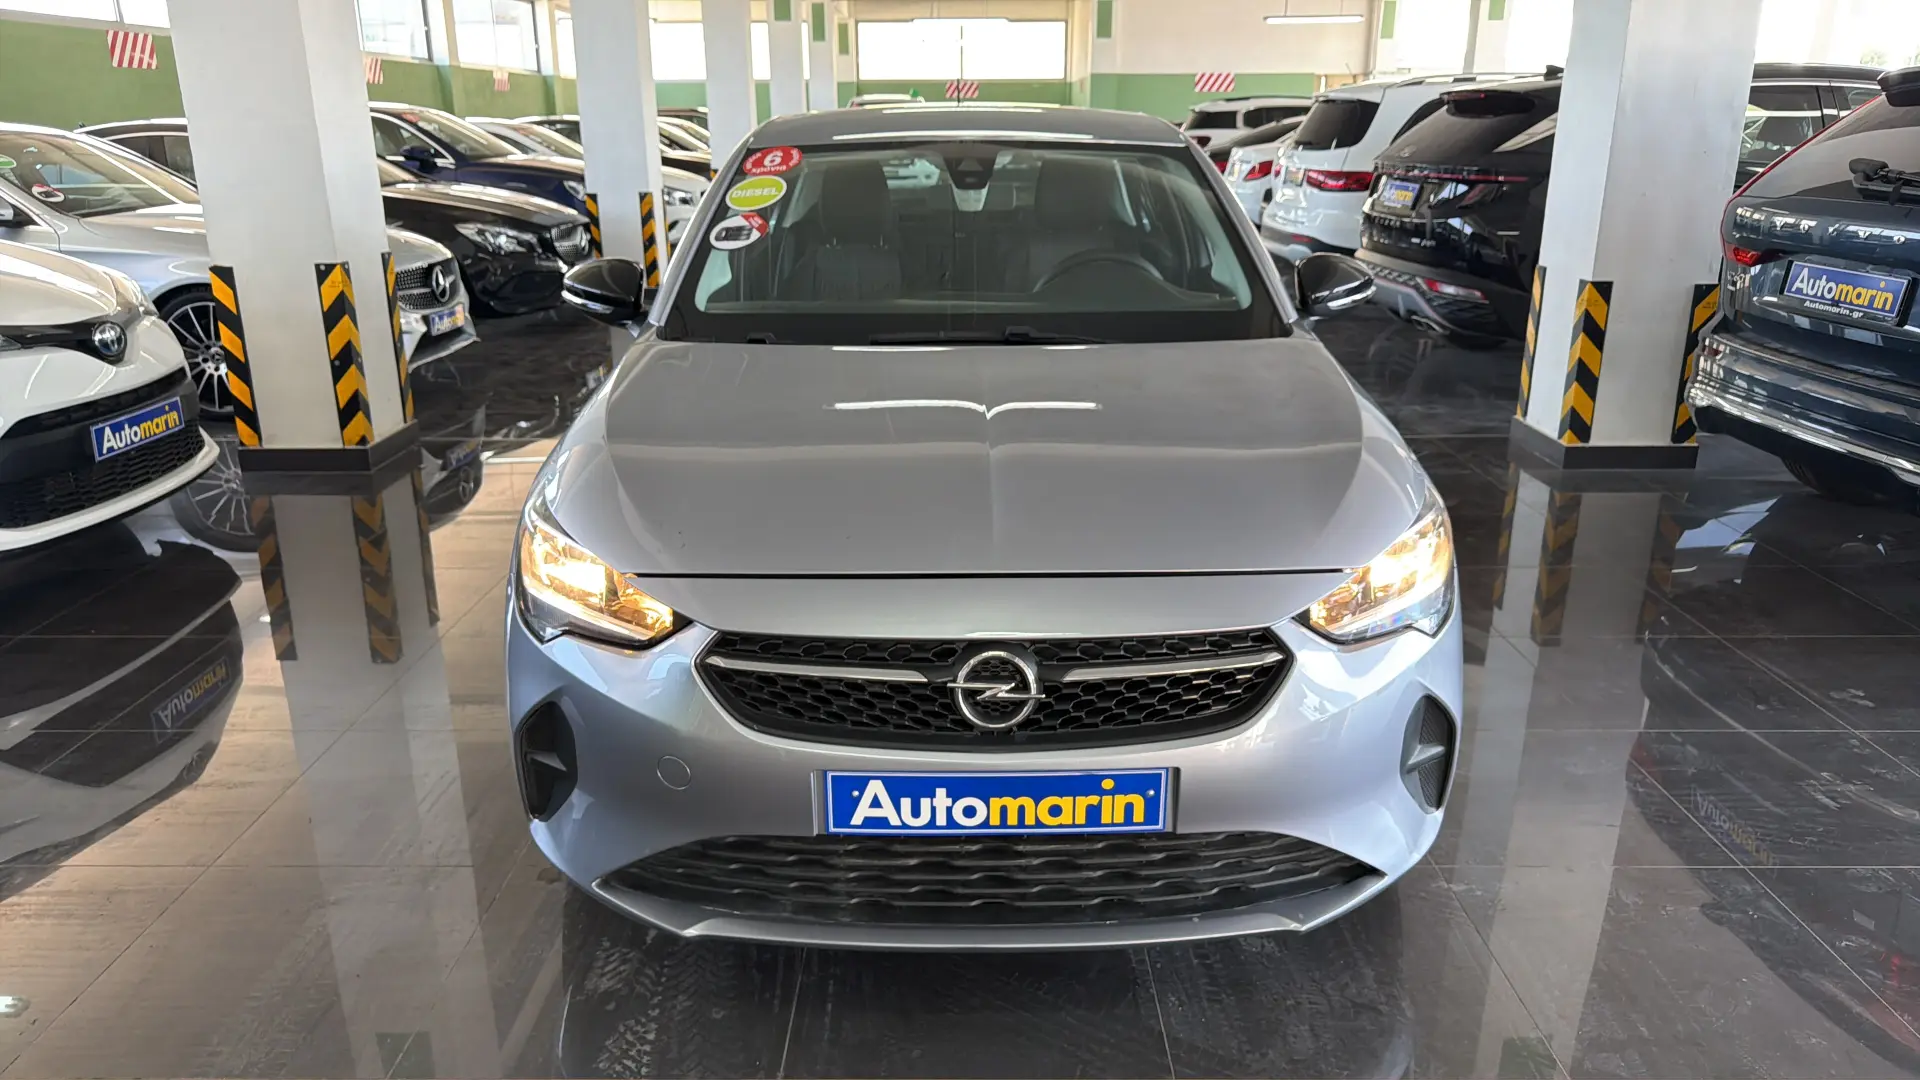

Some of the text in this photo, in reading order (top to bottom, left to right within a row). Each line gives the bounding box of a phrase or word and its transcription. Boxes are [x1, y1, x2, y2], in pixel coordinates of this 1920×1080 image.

[763, 150, 784, 167] 6
[731, 187, 780, 198] DIESEL
[1791, 267, 1894, 311] Automarin
[1804, 300, 1864, 319] Automarin.gr
[102, 405, 180, 454] Automarin
[849, 777, 1145, 828] Automarin
